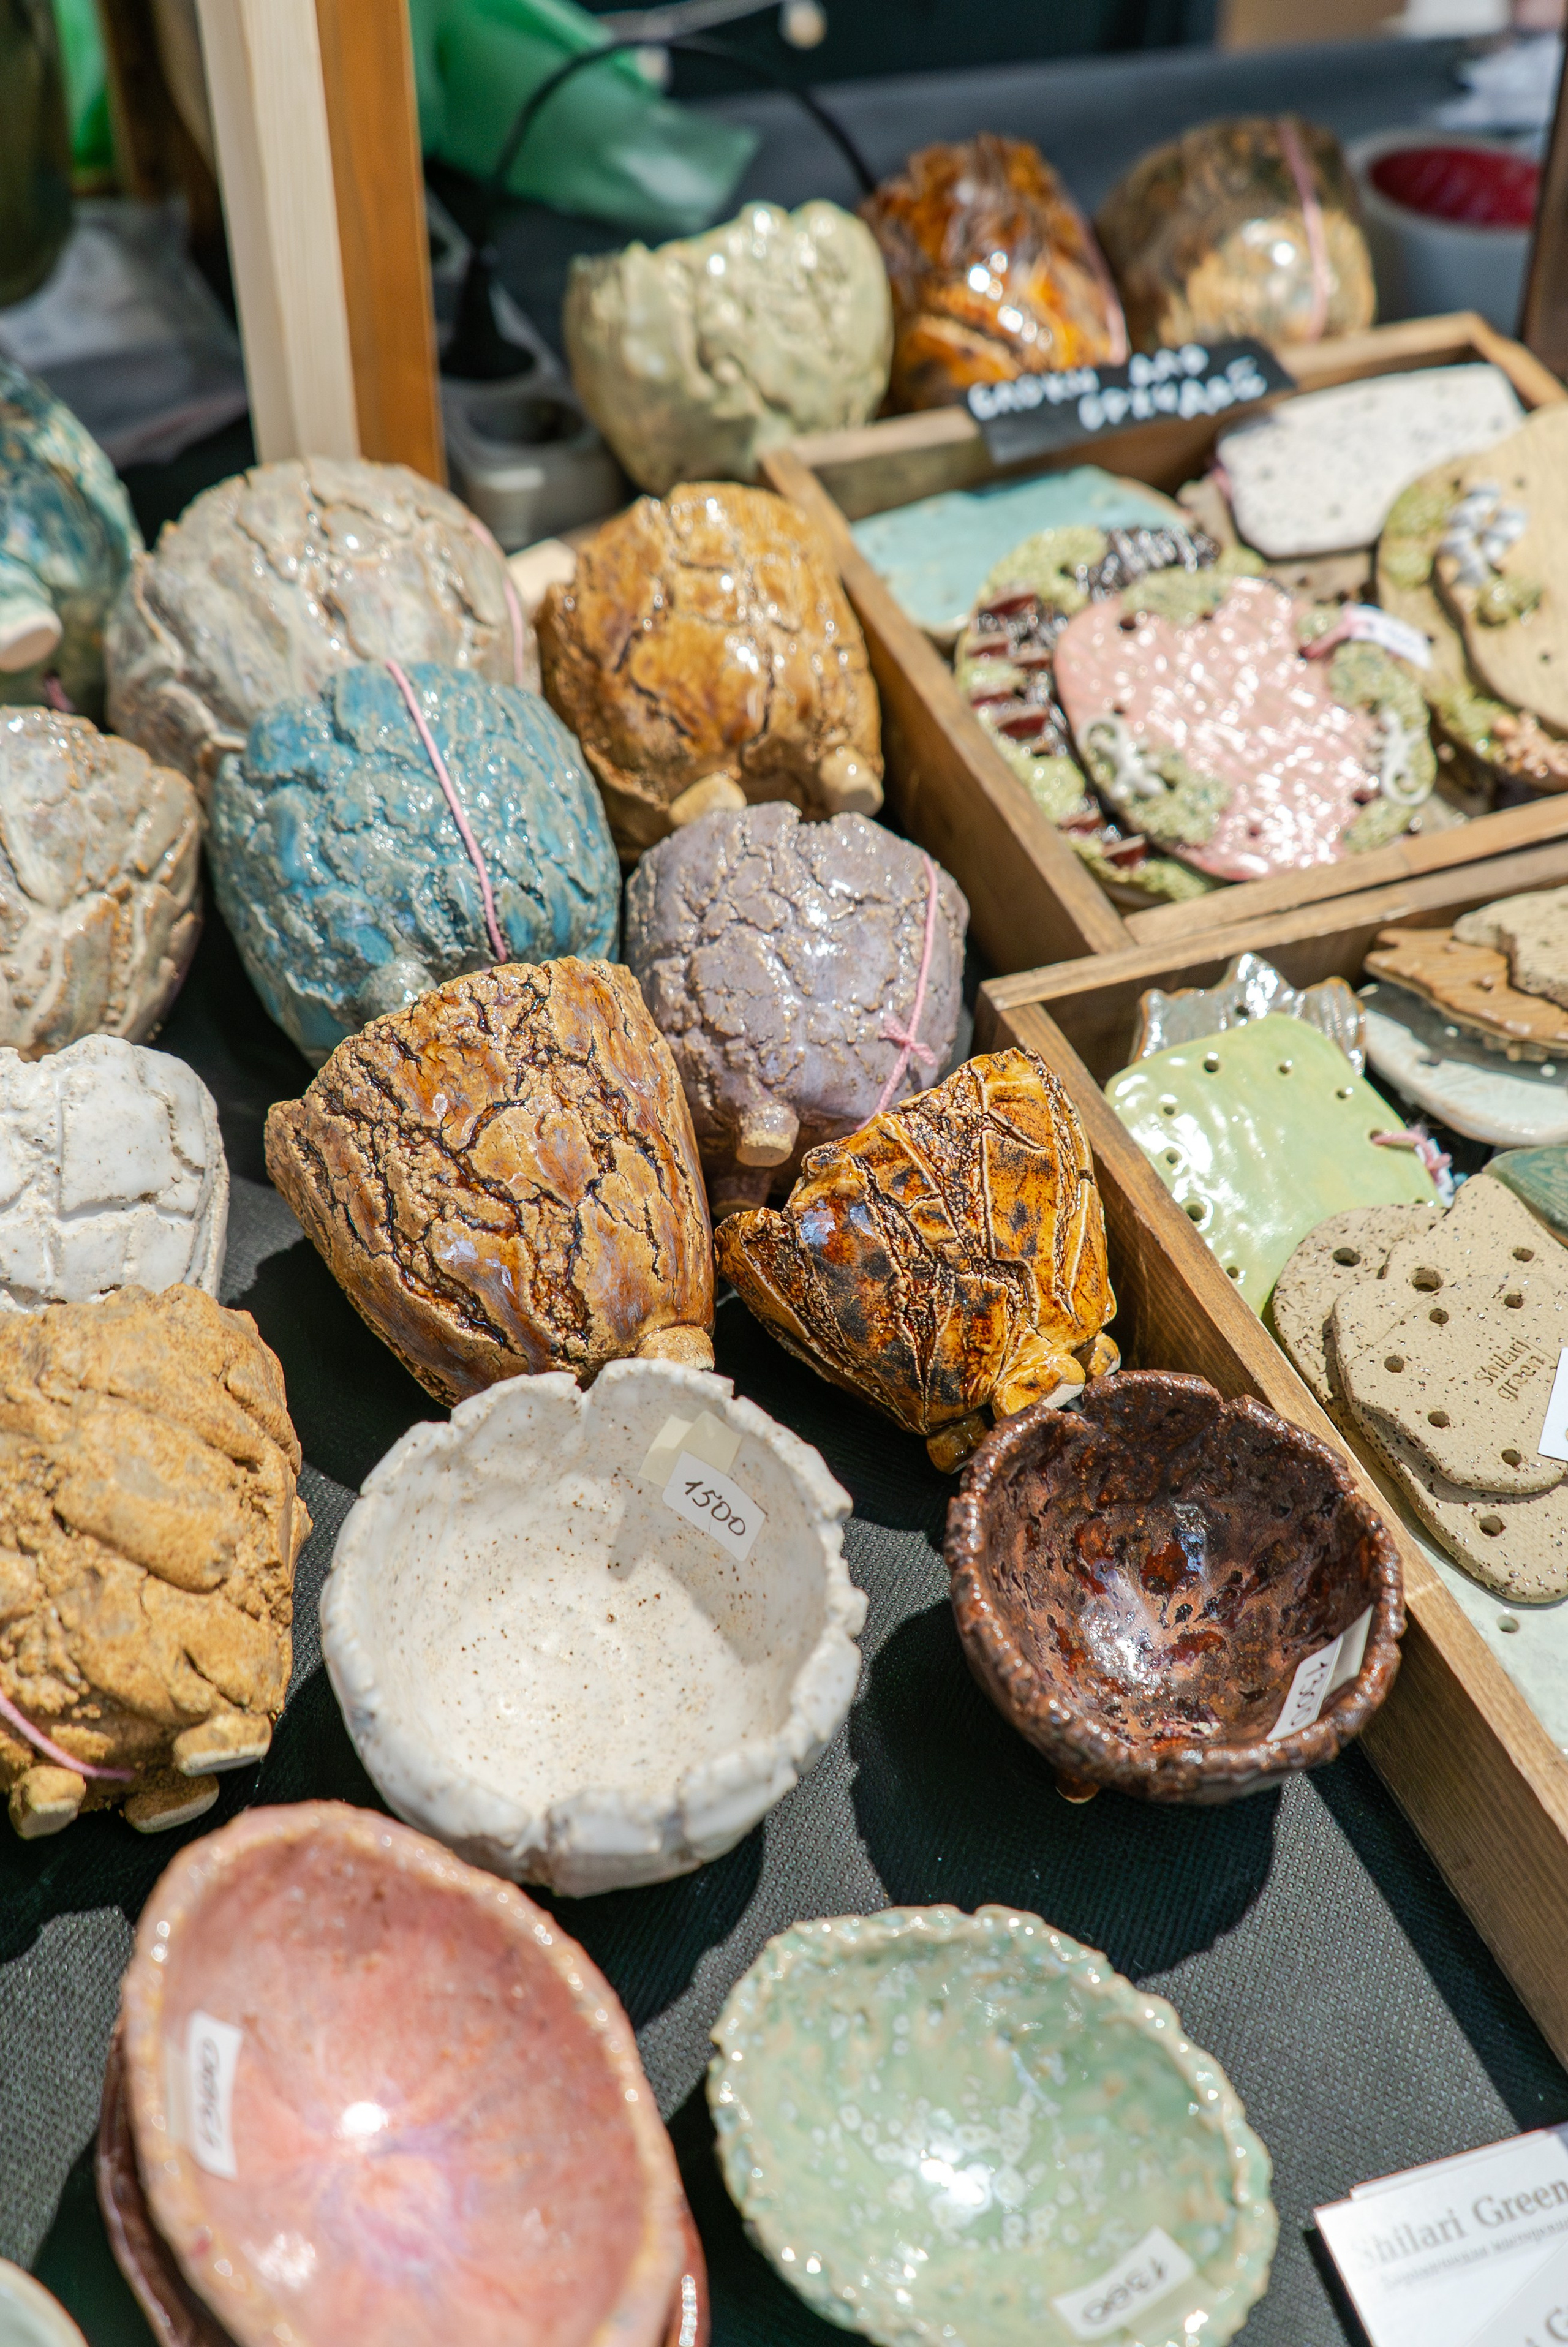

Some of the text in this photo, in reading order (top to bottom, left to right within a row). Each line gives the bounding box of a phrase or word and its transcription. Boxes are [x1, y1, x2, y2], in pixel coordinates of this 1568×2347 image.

[1474, 1336, 1531, 1387] Shilari
[684, 1480, 746, 1536] 1500
[1352, 2207, 1468, 2270] Shilari
[1472, 2179, 1568, 2229] Green
